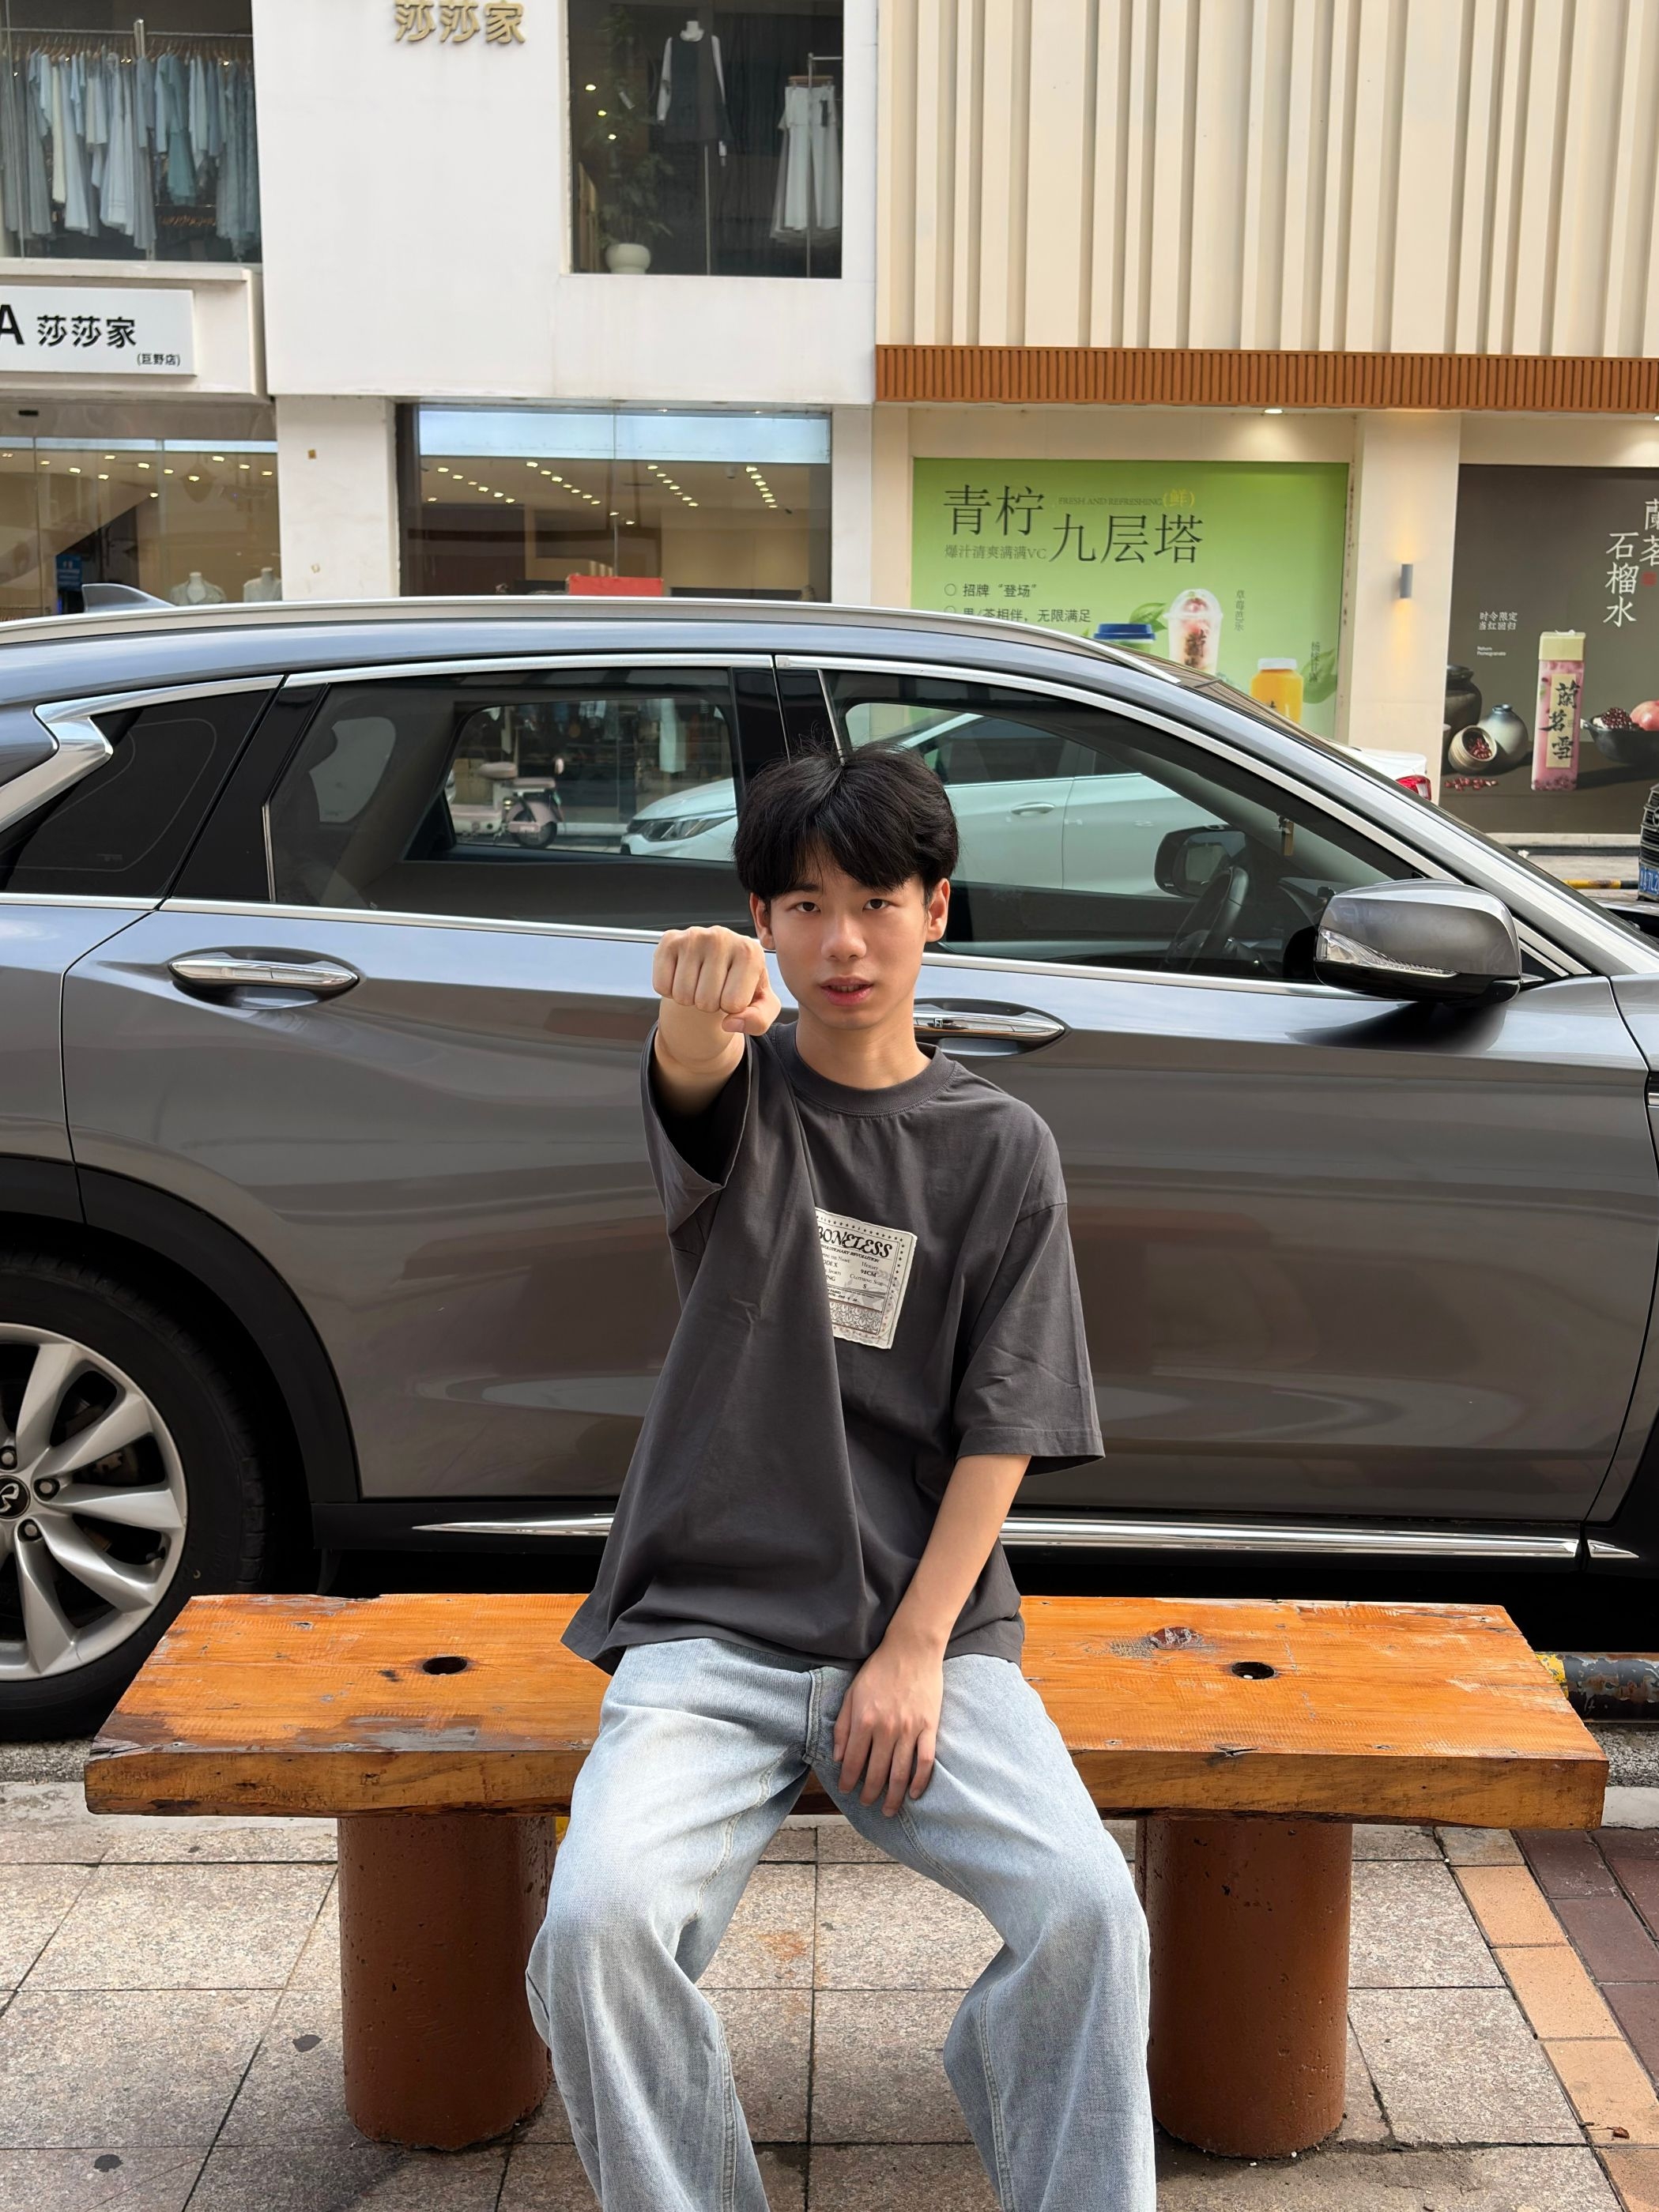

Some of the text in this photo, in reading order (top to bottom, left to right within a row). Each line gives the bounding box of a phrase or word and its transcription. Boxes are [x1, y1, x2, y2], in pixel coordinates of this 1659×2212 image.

[394, 0, 526, 43] 莎莎家
[37, 315, 137, 349] 莎莎家
[944, 484, 1045, 536] 青柠
[1049, 513, 1203, 563] 九层塔
[1603, 532, 1639, 627] 石榴水
